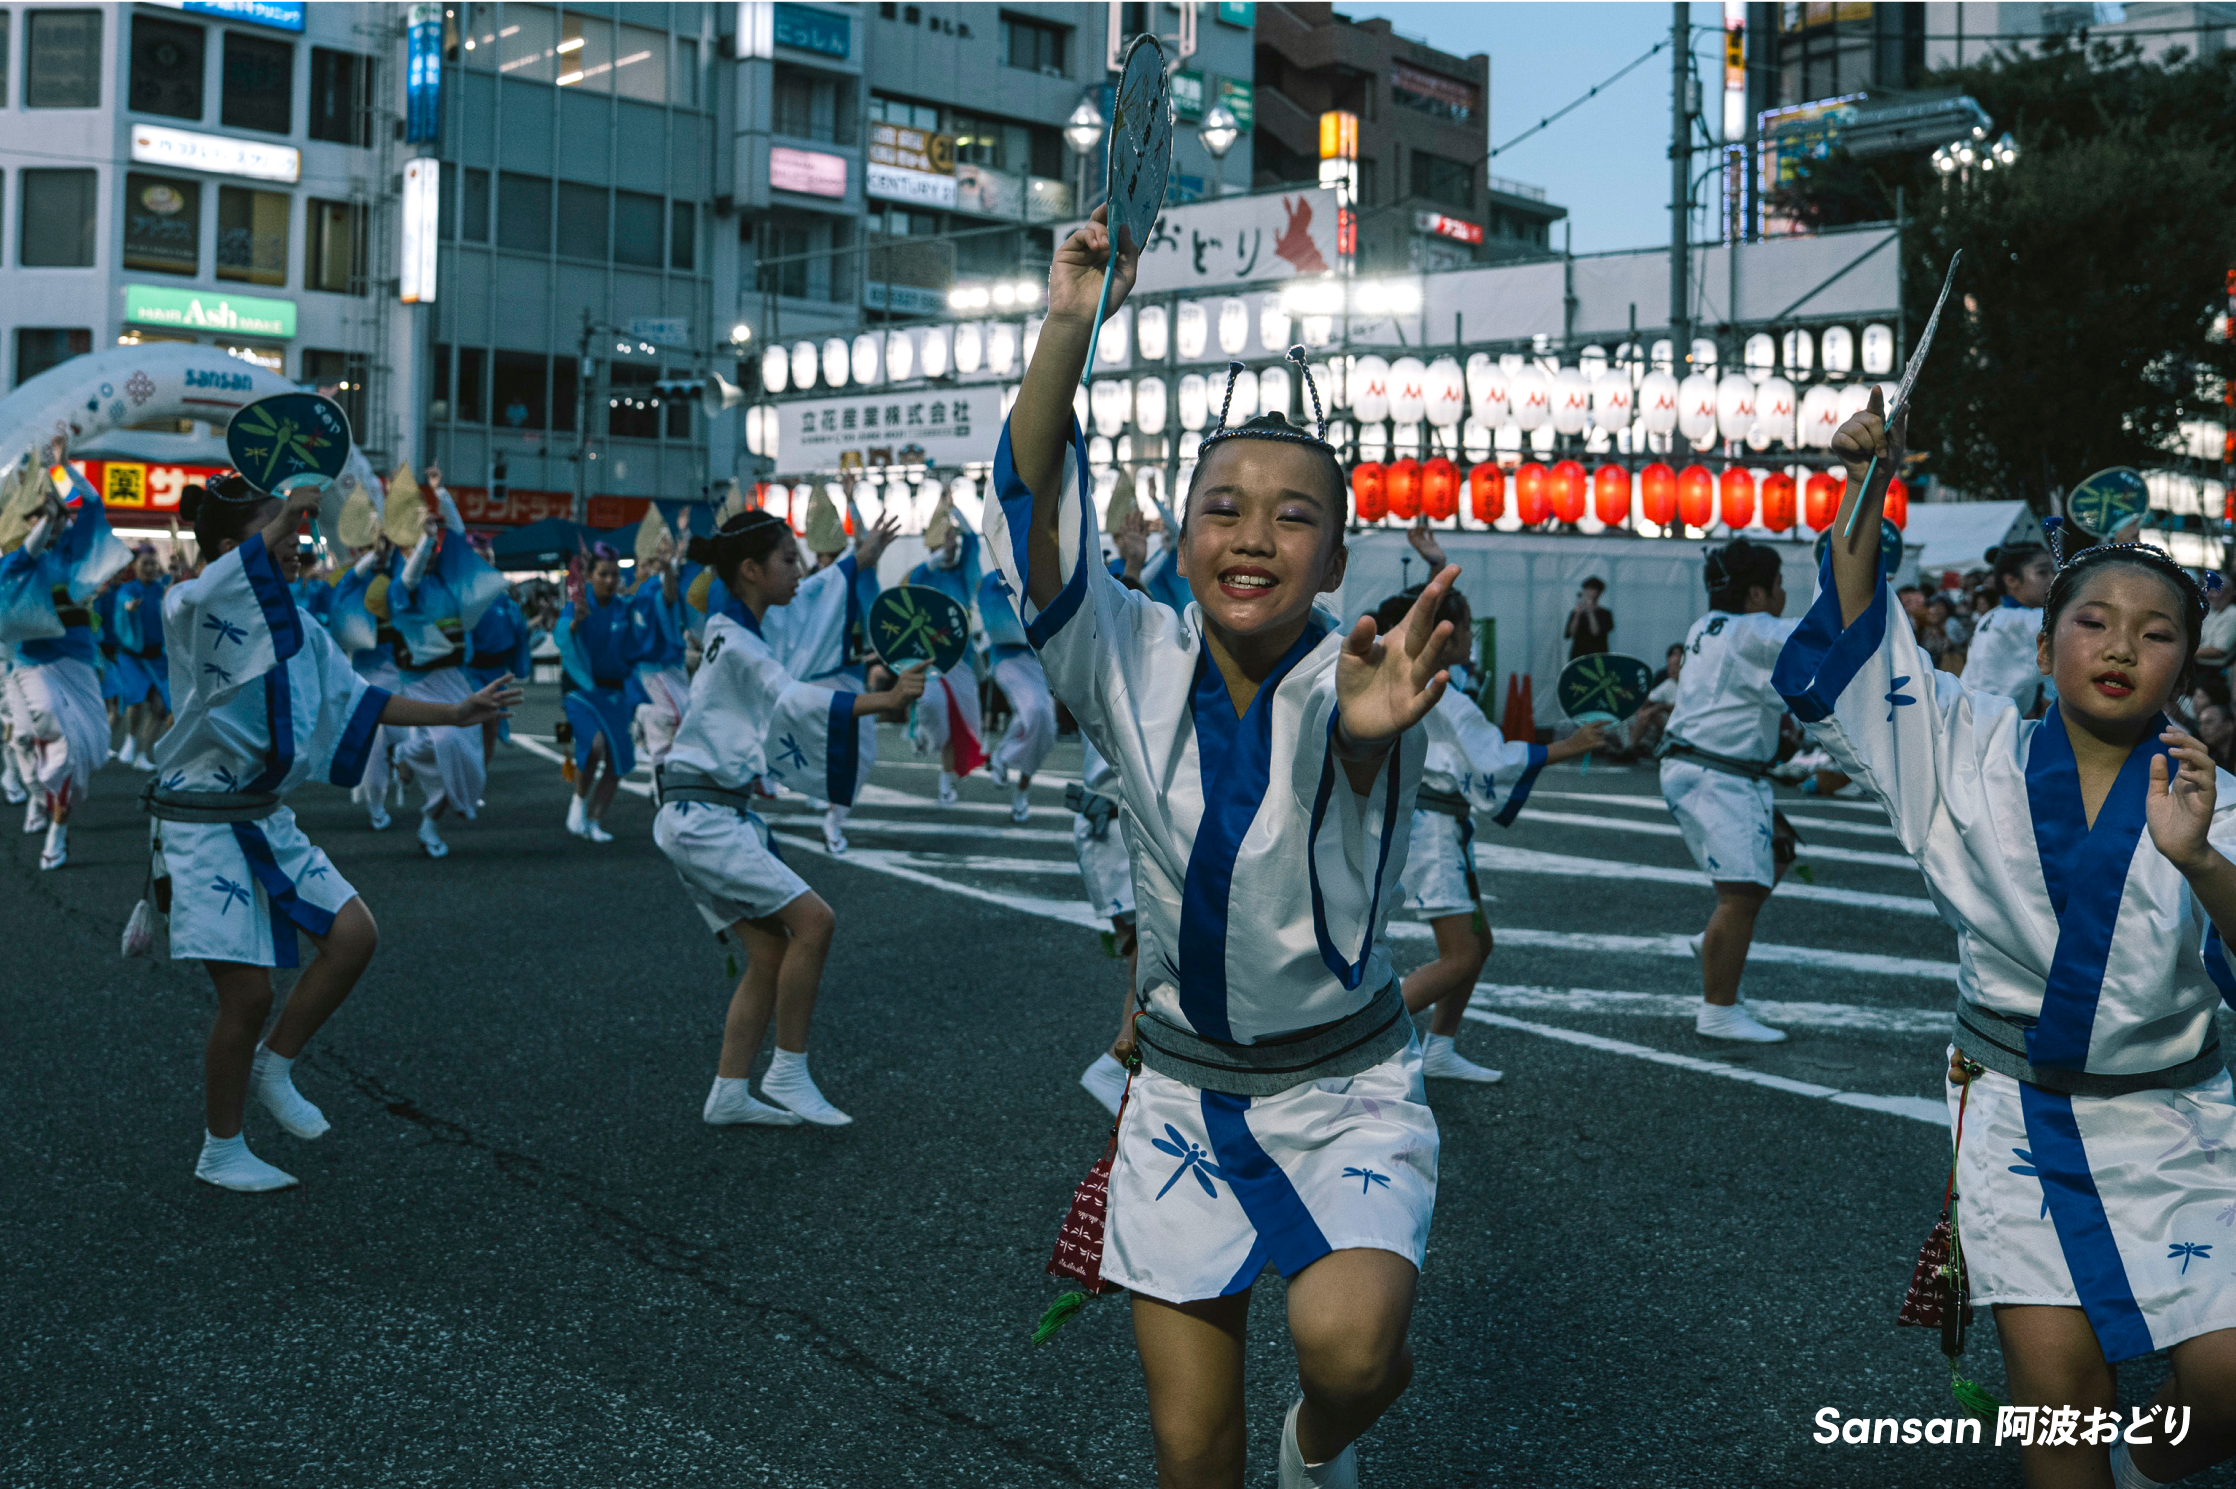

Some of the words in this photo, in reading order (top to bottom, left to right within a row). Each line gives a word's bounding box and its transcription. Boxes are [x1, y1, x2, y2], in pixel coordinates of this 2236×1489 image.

[868, 174, 938, 194] CENTURY
[137, 305, 182, 323] HAIR
[182, 298, 238, 329] Ash
[239, 316, 284, 335] MAKE
[185, 368, 253, 391] sansan
[802, 401, 971, 433] 立花産業株式会社
